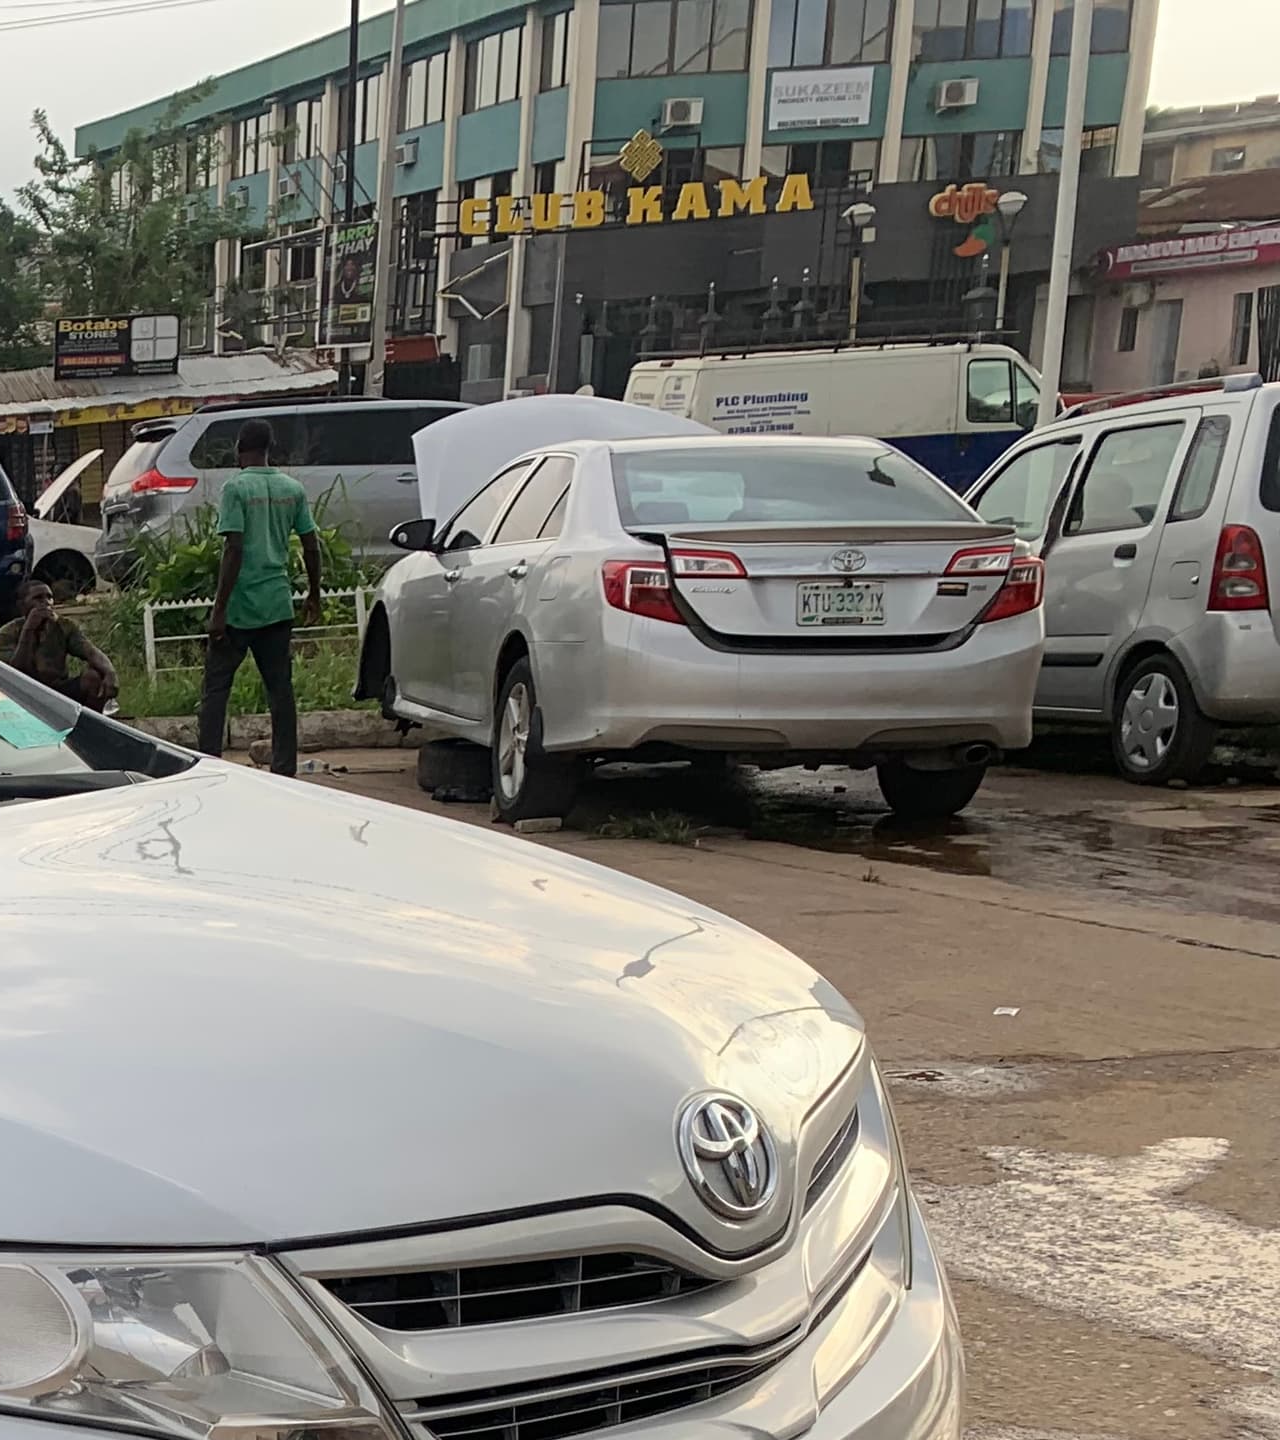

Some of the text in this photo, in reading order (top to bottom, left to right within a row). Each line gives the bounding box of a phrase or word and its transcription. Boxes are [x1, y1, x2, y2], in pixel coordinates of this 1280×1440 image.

[459, 173, 814, 235] CLUB KAMA
[59, 318, 129, 332] Botabs
[69, 329, 118, 340] STORES
[716, 392, 809, 408] PLC Plumbing
